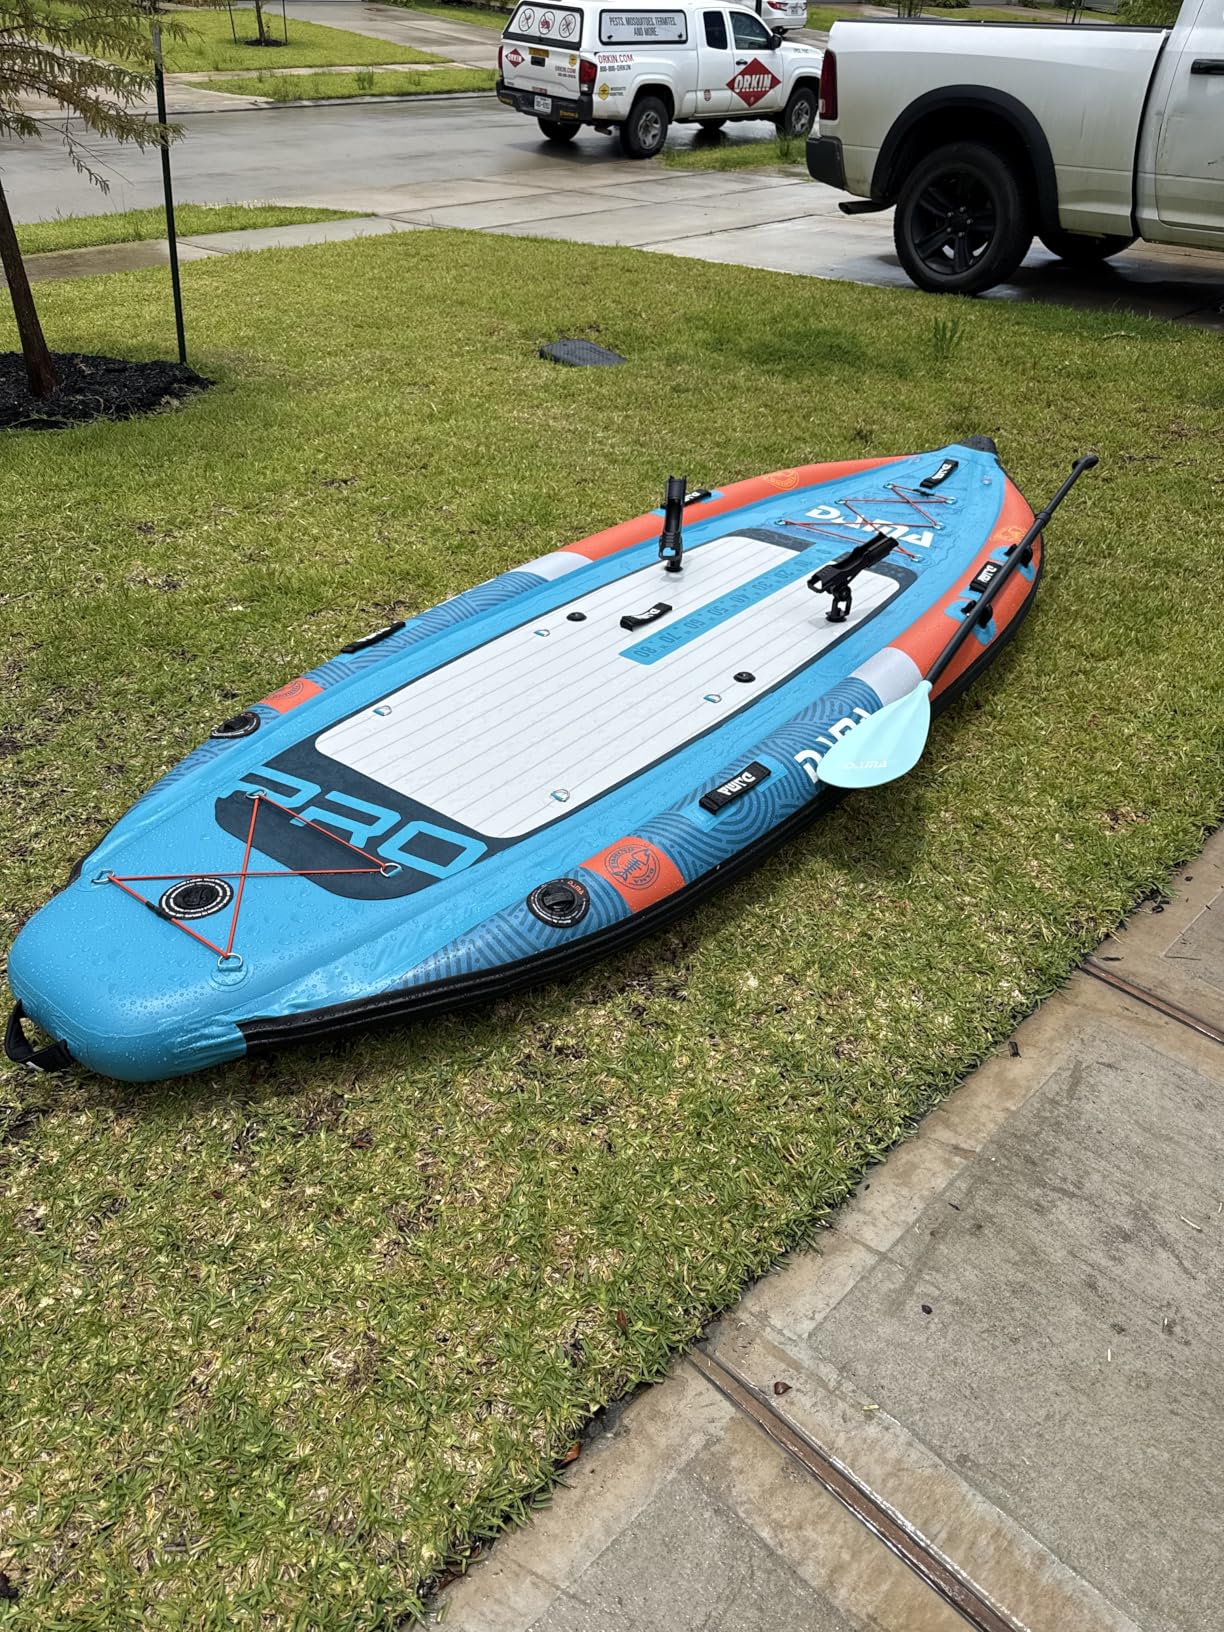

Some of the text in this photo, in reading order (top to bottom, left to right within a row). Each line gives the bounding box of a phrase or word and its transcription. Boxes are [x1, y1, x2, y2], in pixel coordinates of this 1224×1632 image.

[608, 16, 625, 26] PESTS.
[633, 27, 659, 36] AND MORE.
[507, 53, 523, 63] ORKIN
[598, 54, 634, 64] ORKIN.COM
[734, 73, 773, 92] ORKIN
[707, 605, 729, 616] 50
[683, 618, 706, 630] 60
[658, 632, 683, 643] 70
[633, 645, 657, 659] 80
[216, 764, 488, 879] PRO
